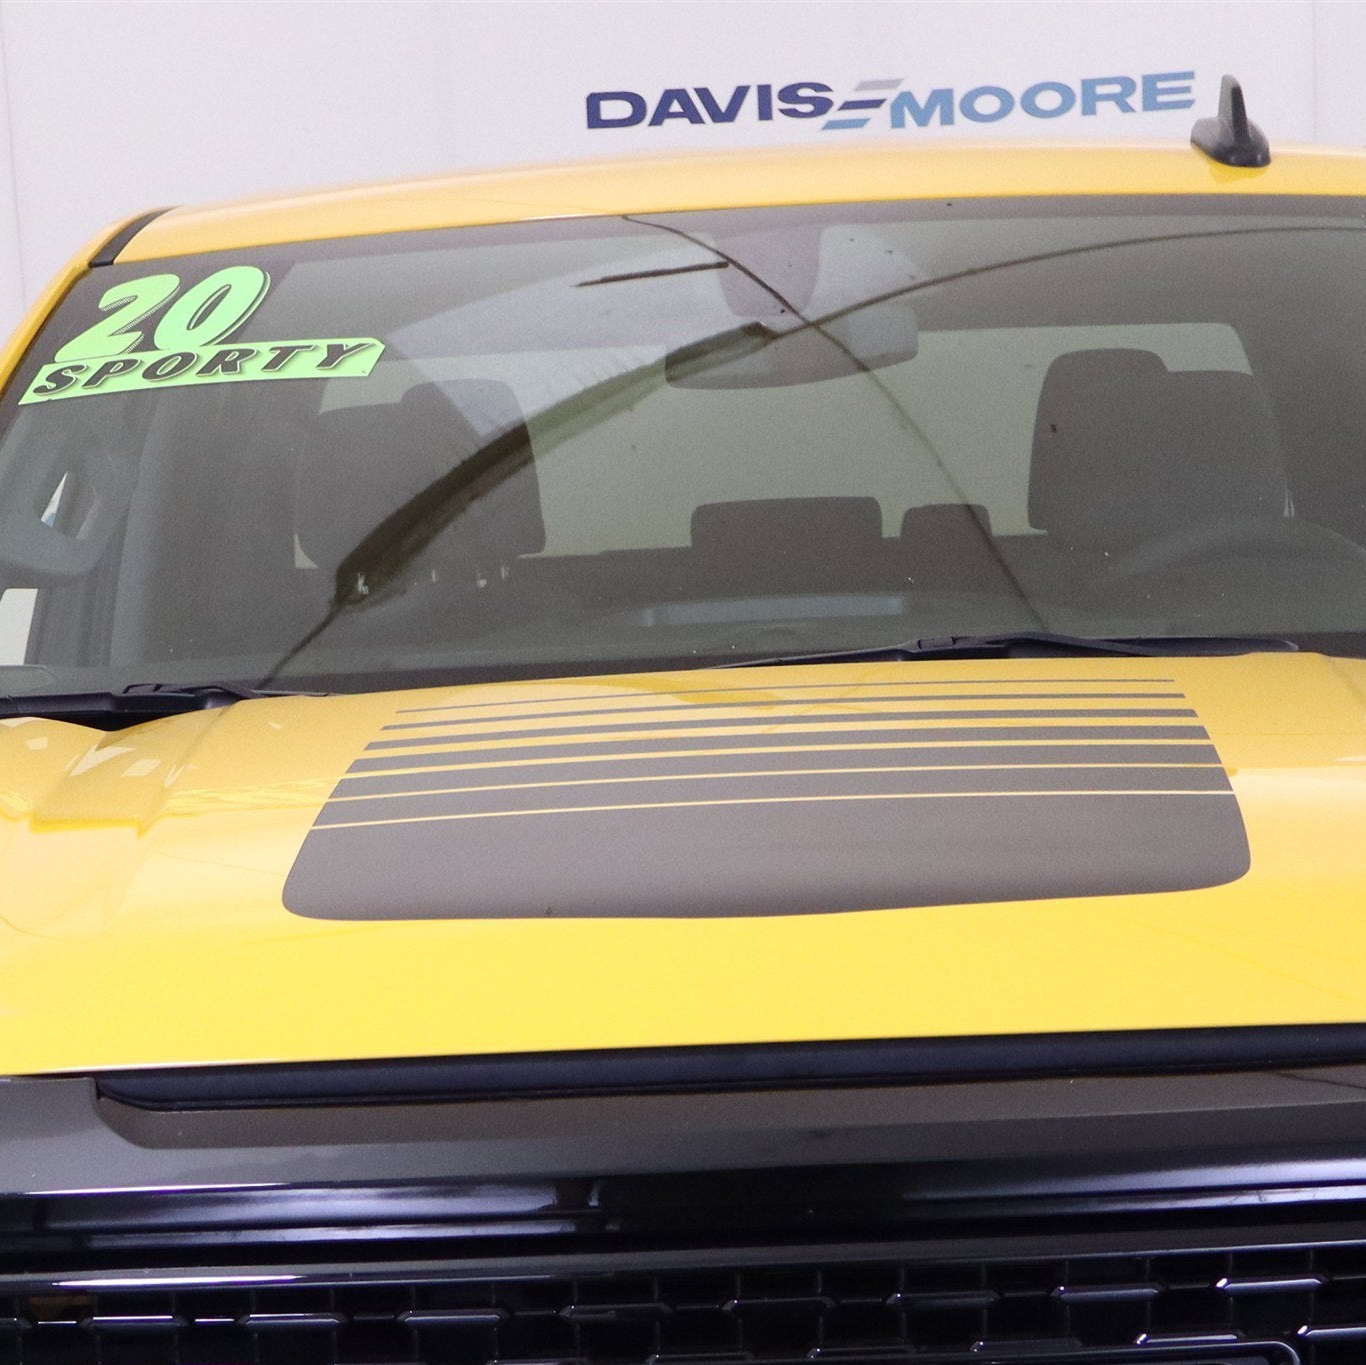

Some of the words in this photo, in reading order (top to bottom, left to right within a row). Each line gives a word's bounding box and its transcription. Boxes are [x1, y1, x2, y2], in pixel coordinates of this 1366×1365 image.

[586, 82, 834, 130] DAVIS
[889, 70, 1196, 129] MOORE
[54, 265, 272, 363] 20
[32, 341, 378, 397] SPORTY
